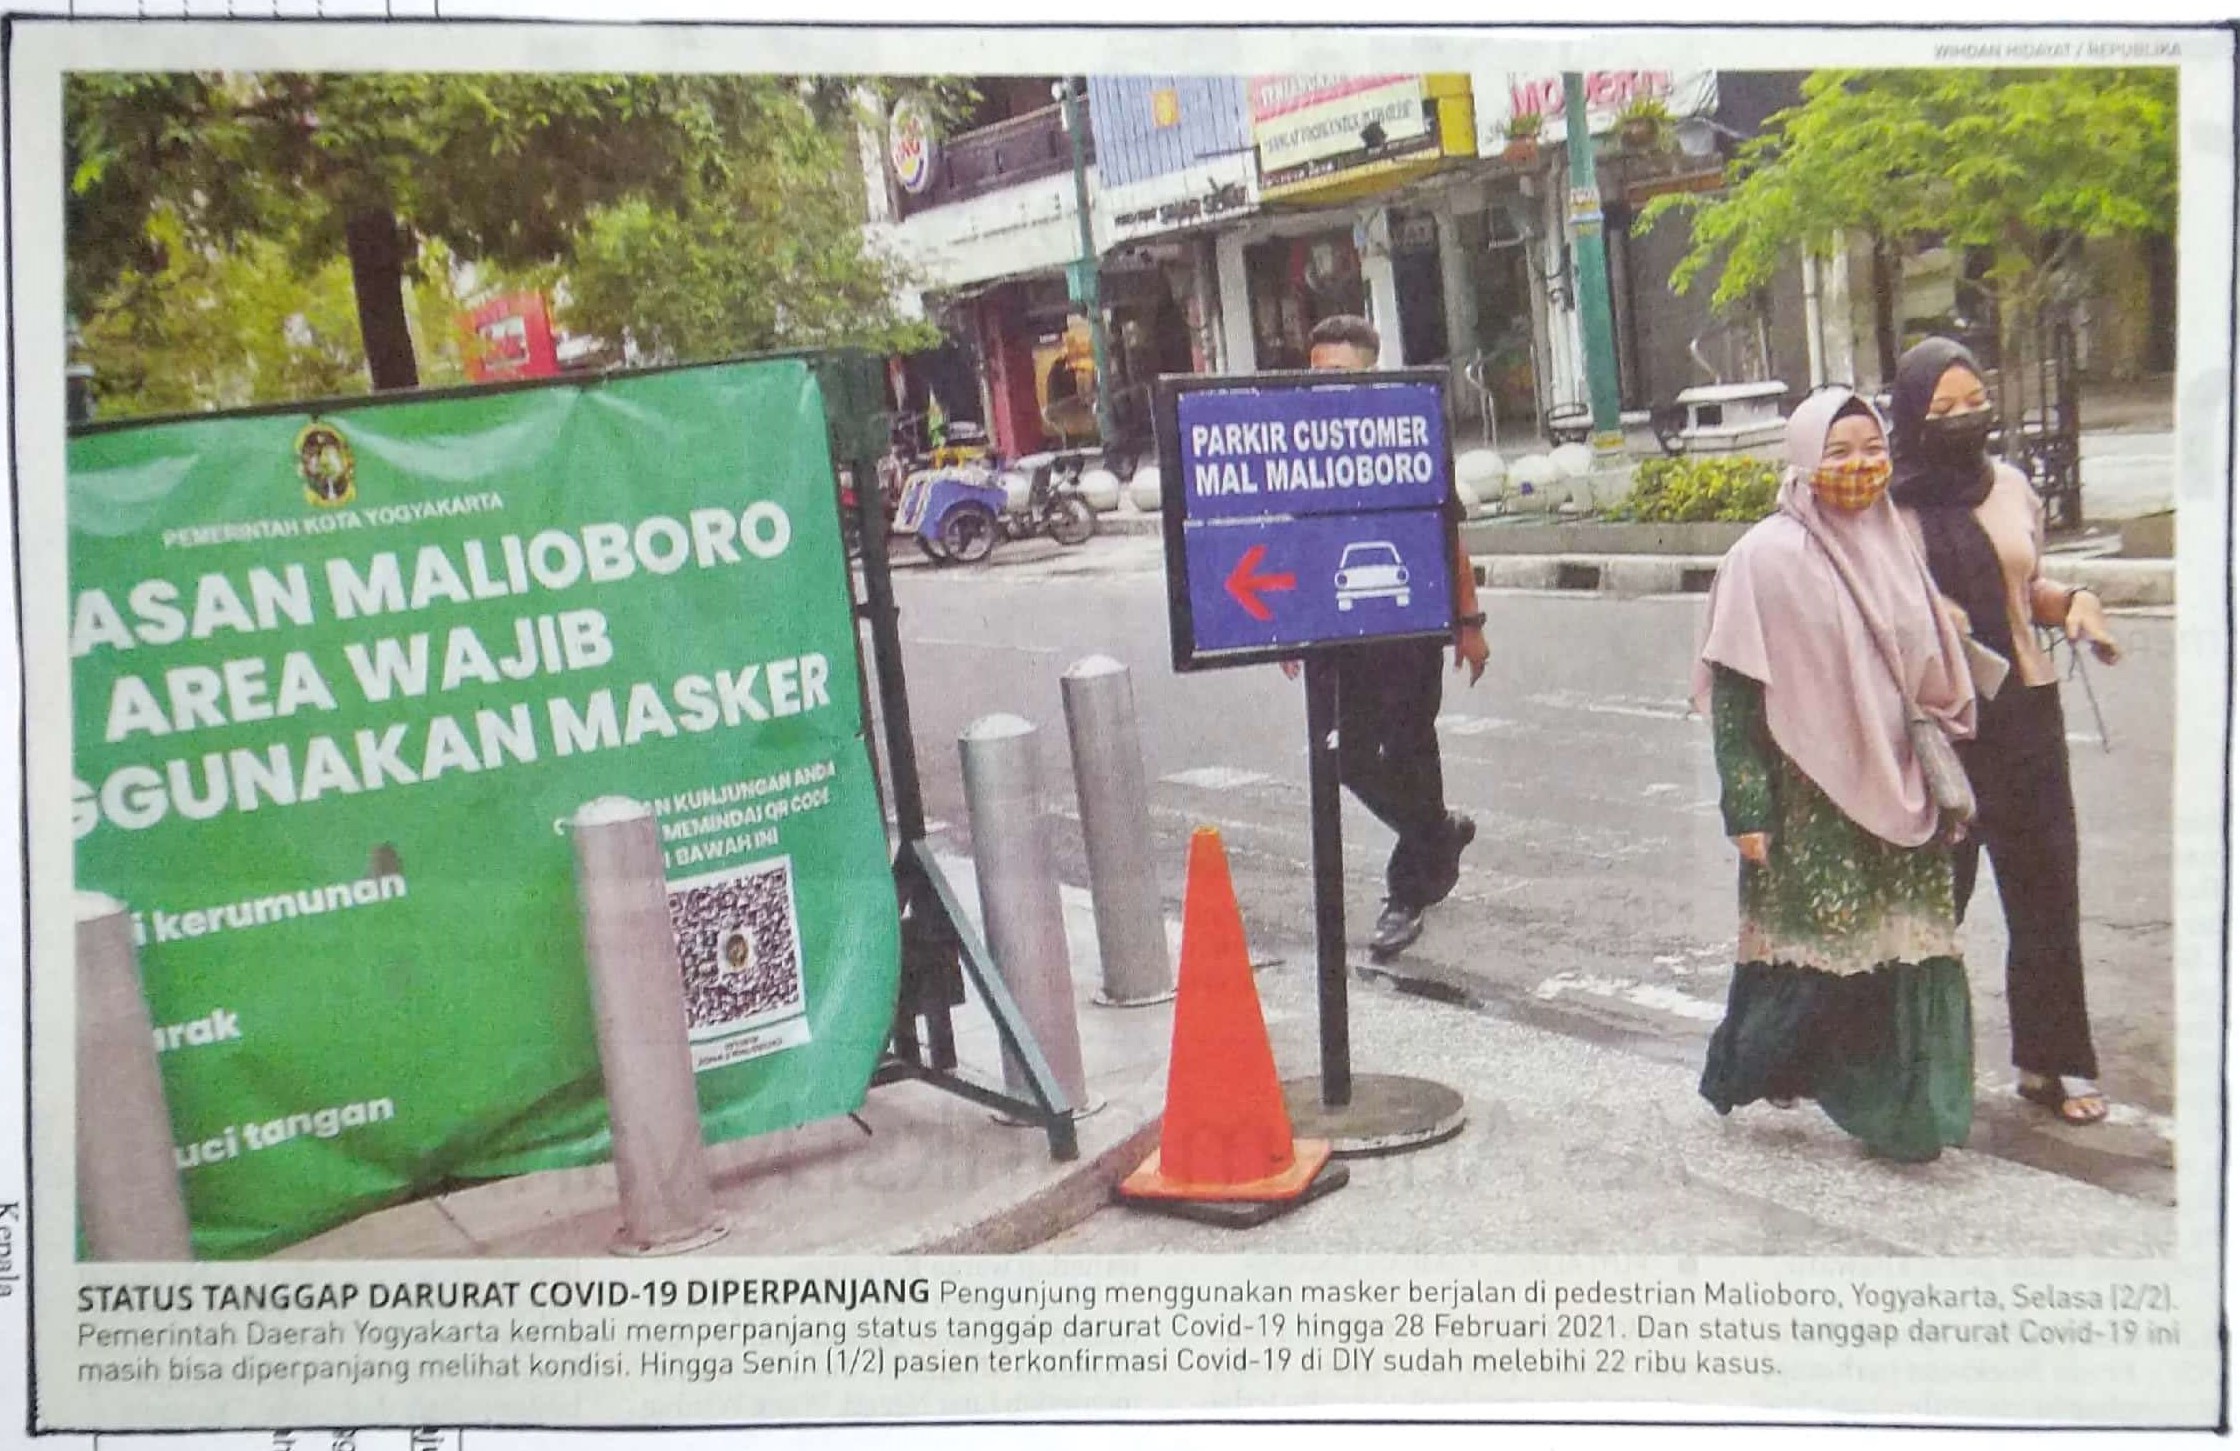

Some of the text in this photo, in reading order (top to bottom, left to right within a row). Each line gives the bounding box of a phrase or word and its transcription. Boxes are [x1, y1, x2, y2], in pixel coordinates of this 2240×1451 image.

[2006, 42, 2071, 58] HIDAYAT
[2088, 41, 2182, 57] REPUBLIKA
[1192, 415, 1429, 457] PARKIR CUSTOMER
[1195, 451, 1433, 496] MAL MALIOBORO
[162, 491, 504, 548] PEMERINTAH KOTA YOGYAKARTA
[69, 499, 794, 658] ASAN MALIOBORO
[105, 608, 614, 742] AREA WAJIB
[550, 652, 833, 757] MASKER
[672, 777, 791, 810] KUNJUNGAN
[795, 761, 836, 785] ANDA
[676, 833, 752, 865] BAWAH
[754, 828, 778, 849] INI
[153, 873, 407, 943] kerumunan
[242, 1097, 395, 1152] tangan
[78, 1283, 193, 1312] STATUS
[202, 1282, 359, 1311] TANGGAP
[369, 1281, 520, 1310] DARURAT
[530, 1280, 678, 1308] COVID-19
[688, 1279, 930, 1310] DIPERPANJANG
[941, 1280, 1096, 1310] Pengunjung
[1106, 1279, 1293, 1310] menggunakan
[1302, 1279, 1401, 1303] masker
[1409, 1279, 1516, 1309] berjalan
[1525, 1279, 1546, 1304] di
[1556, 1280, 1696, 1310] pedestrian
[1705, 1281, 1844, 1309] Malioboro,
[1852, 1282, 2005, 1312] Yogyakarta,
[2013, 1283, 2102, 1310] Selasa
[78, 1313, 2181, 1350] Pemerintah Daerah Yogyakarta kembali memperpanjang status tanggap darurat Covid-19 hingga 28 Februari 2021. Dan status tanggap darurat Covid-19 ini
[78, 1347, 1783, 1385] masih bisa diperpanjang melihat kondisi. Hingga Senin (1/2) pasien terkonfirmasi Covid-19 di DIY sudah melebihi 22 ribu kasus.
